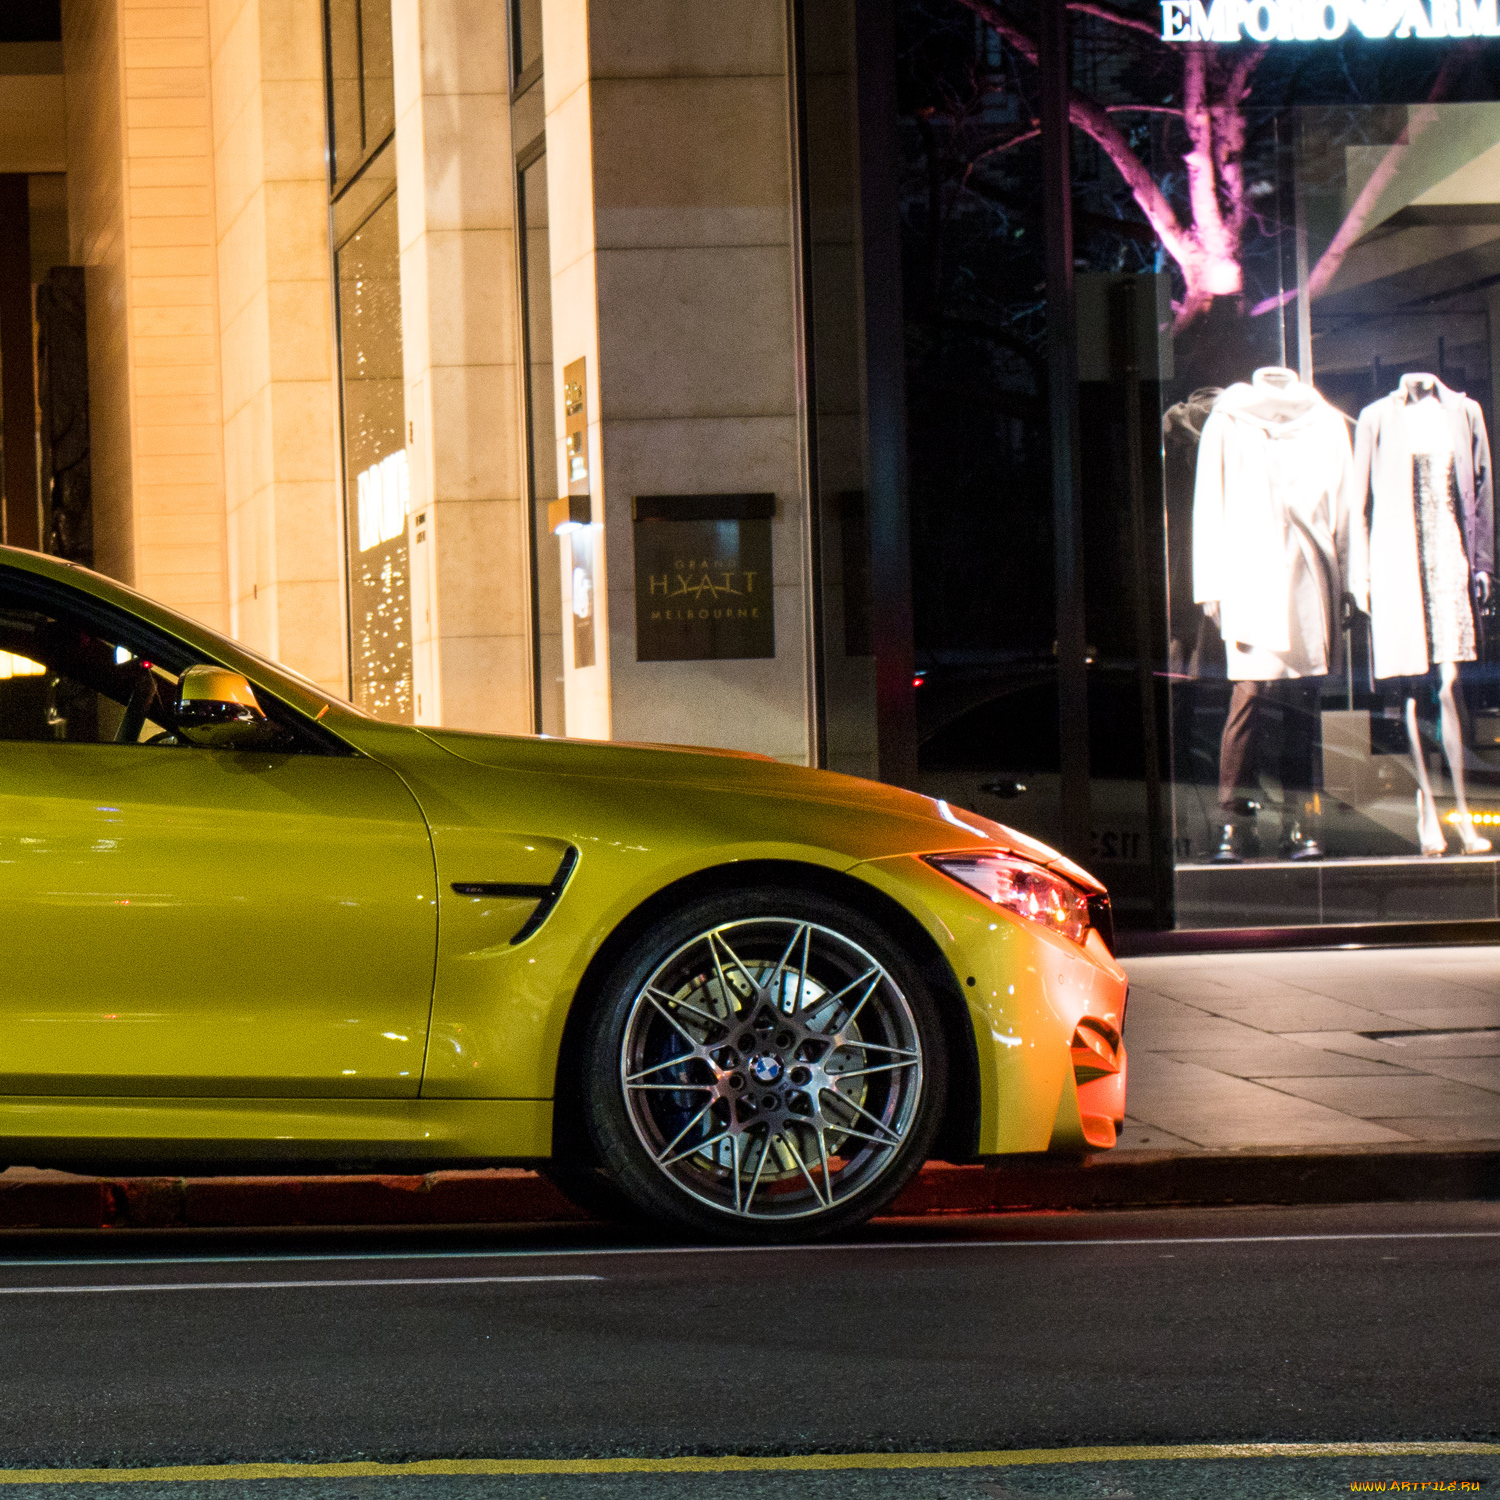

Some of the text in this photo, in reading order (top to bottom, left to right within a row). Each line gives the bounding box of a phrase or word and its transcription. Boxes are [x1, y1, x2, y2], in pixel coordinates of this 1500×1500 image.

[1160, 0, 1349, 41] EMPORIO
[675, 559, 737, 570] GRAND
[650, 571, 757, 599] HYATT
[651, 607, 759, 620] MELBOURNE
